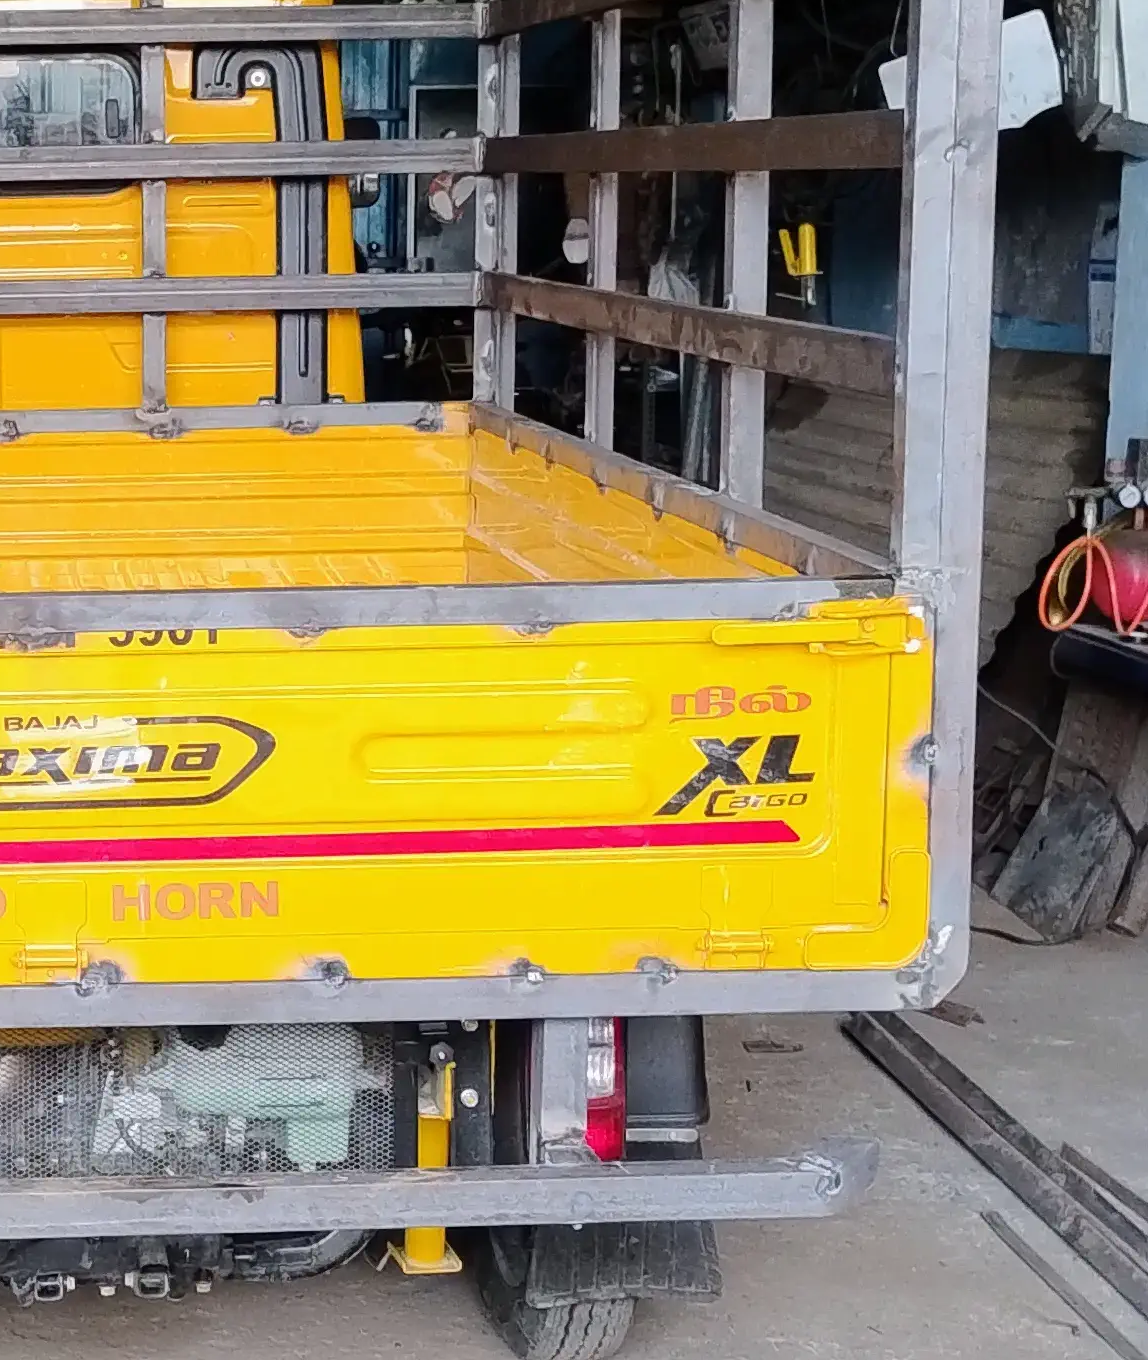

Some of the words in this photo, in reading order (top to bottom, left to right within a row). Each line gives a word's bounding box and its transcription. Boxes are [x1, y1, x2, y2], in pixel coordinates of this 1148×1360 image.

[4, 715, 99, 732] BAJAJ
[669, 685, 812, 723] நில்
[654, 734, 815, 816] XL
[112, 880, 280, 923] HORN
